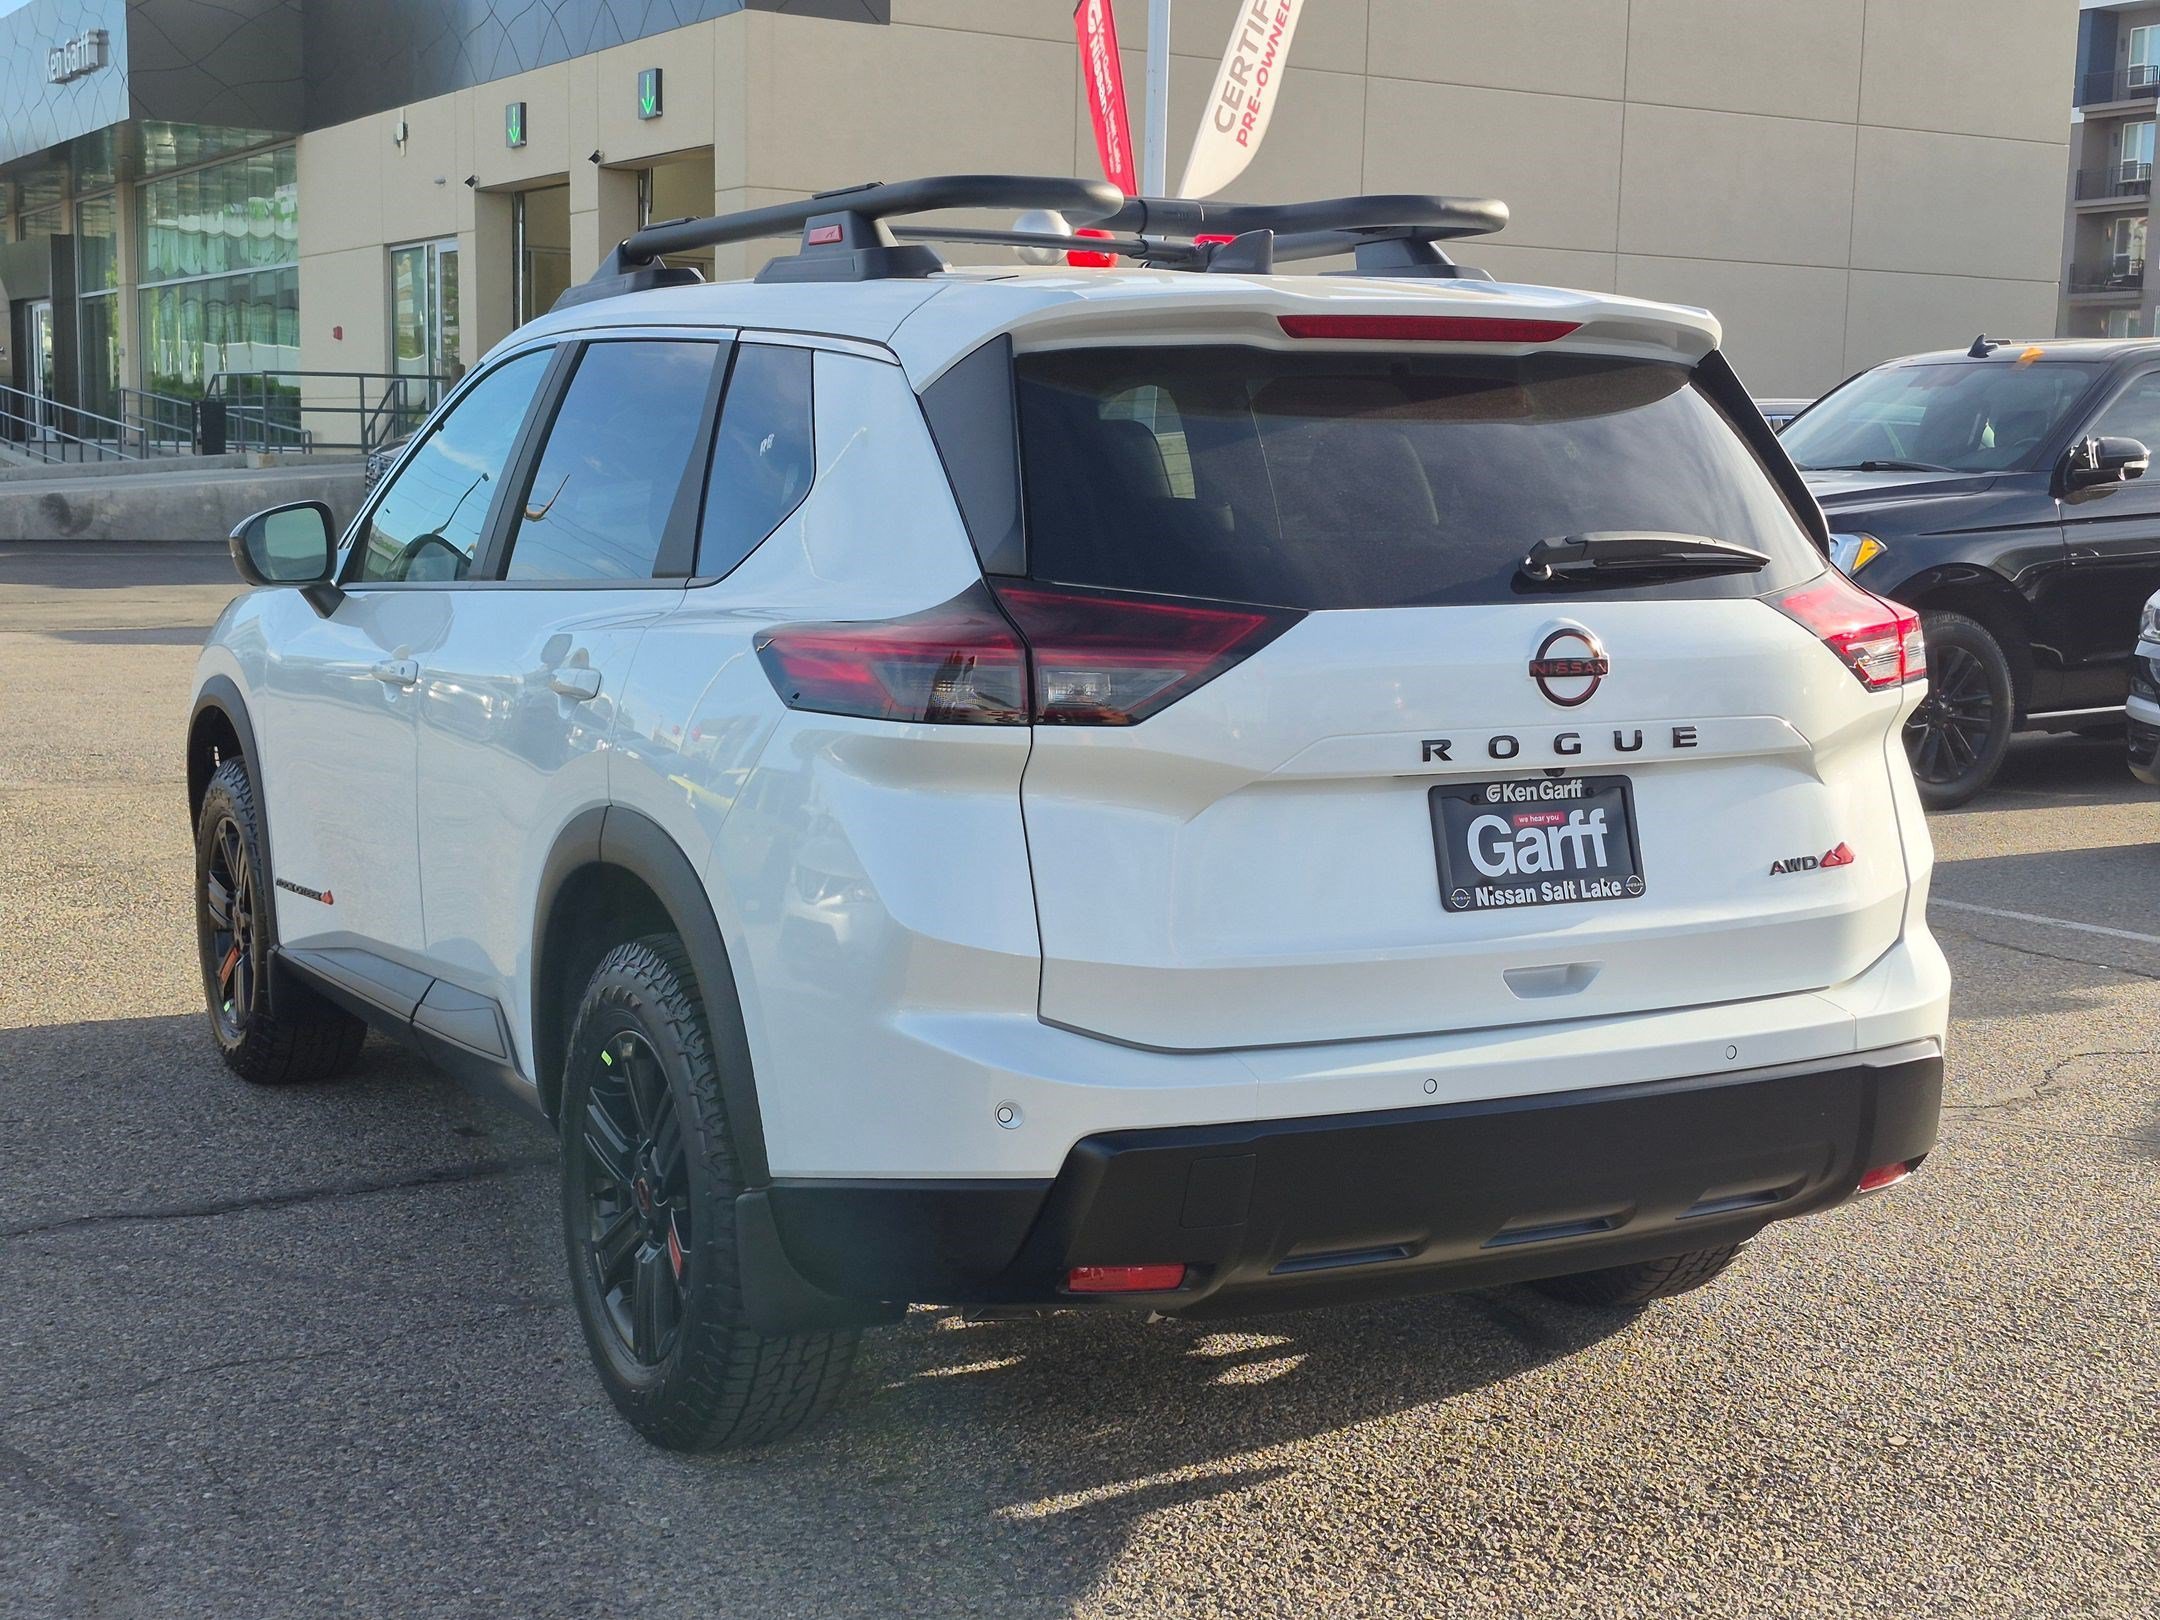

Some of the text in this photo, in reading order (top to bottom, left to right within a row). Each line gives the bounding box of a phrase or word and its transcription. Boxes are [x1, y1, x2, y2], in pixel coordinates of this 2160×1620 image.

[1530, 660, 1608, 676] NISSAN
[1421, 726, 1698, 762] ROGUE
[1502, 779, 1583, 802] Ken Garff
[1529, 814, 1545, 823] hear
[1546, 814, 1560, 823] you
[1467, 808, 1608, 878] Garff
[1768, 855, 1819, 876] AWD
[1475, 878, 1622, 907] Nissan Salt Lake
